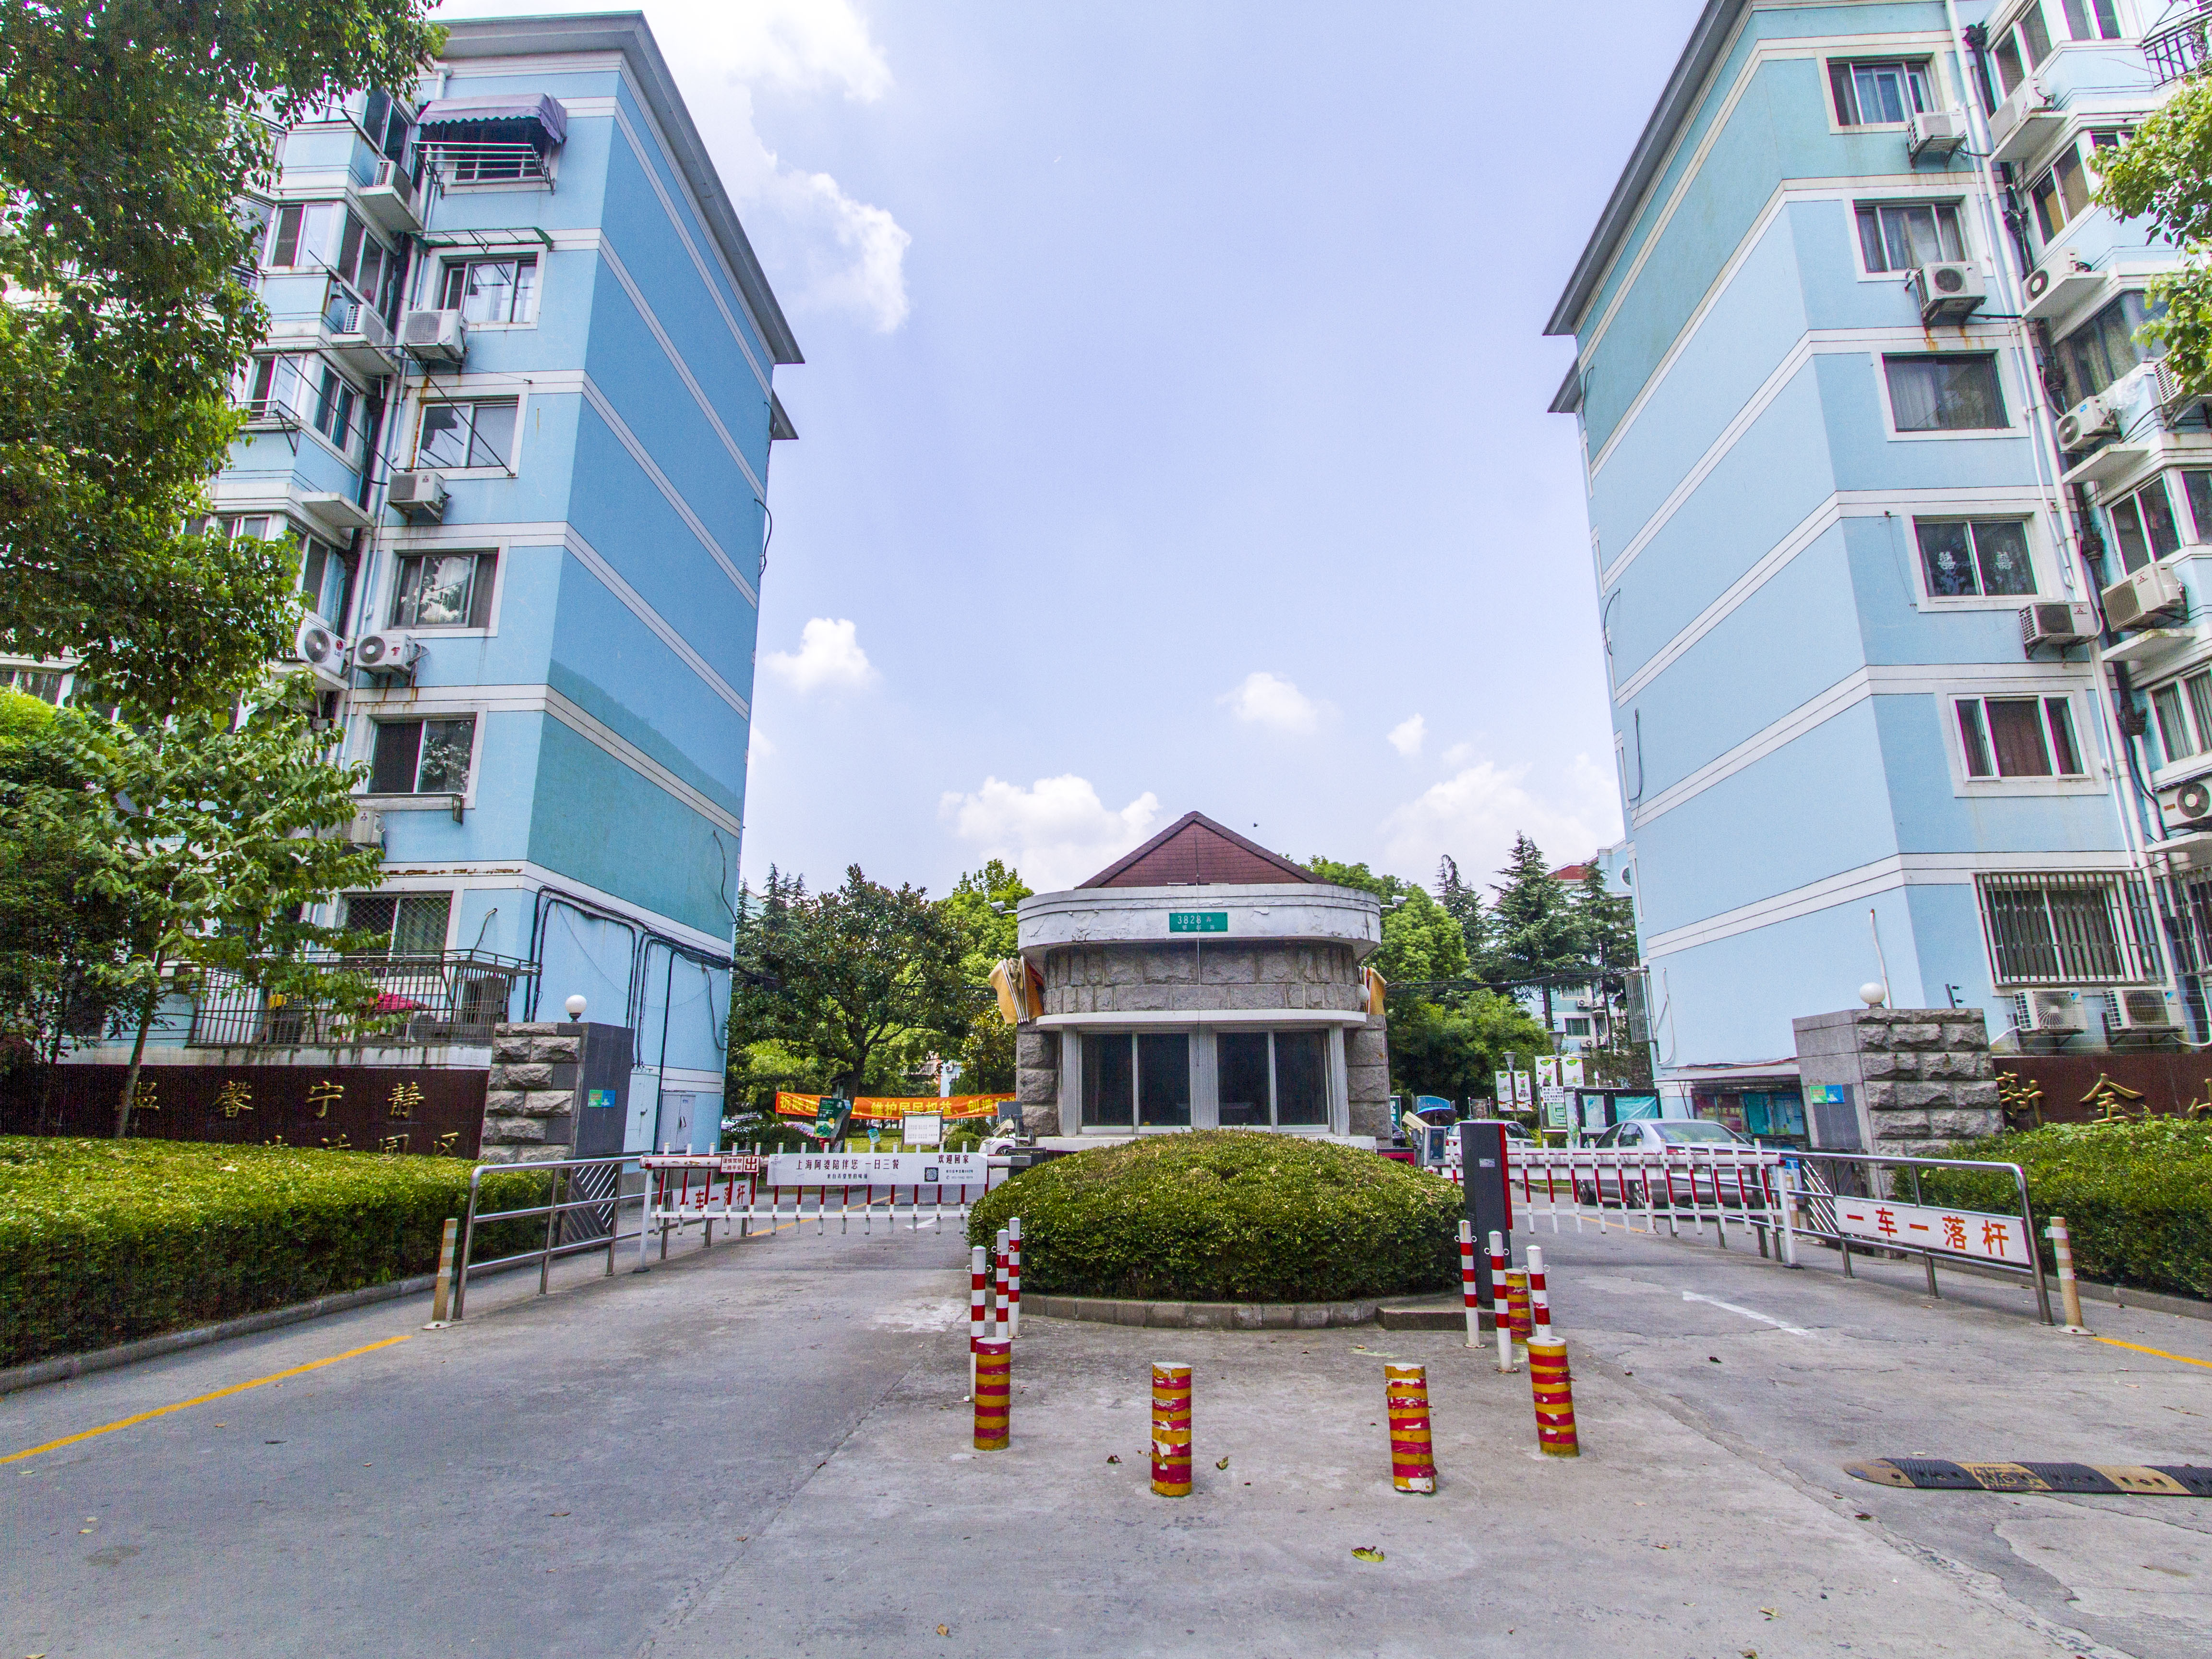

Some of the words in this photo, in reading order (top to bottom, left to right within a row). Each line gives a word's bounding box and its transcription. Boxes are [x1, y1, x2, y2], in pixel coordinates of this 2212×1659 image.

[796, 1159, 858, 1170] 上海阿婆陪伴您
[866, 1159, 899, 1169] 一日三餐
[938, 1154, 969, 1164] 欢迎回家
[1847, 1207, 2009, 1257] 一车一落杆
